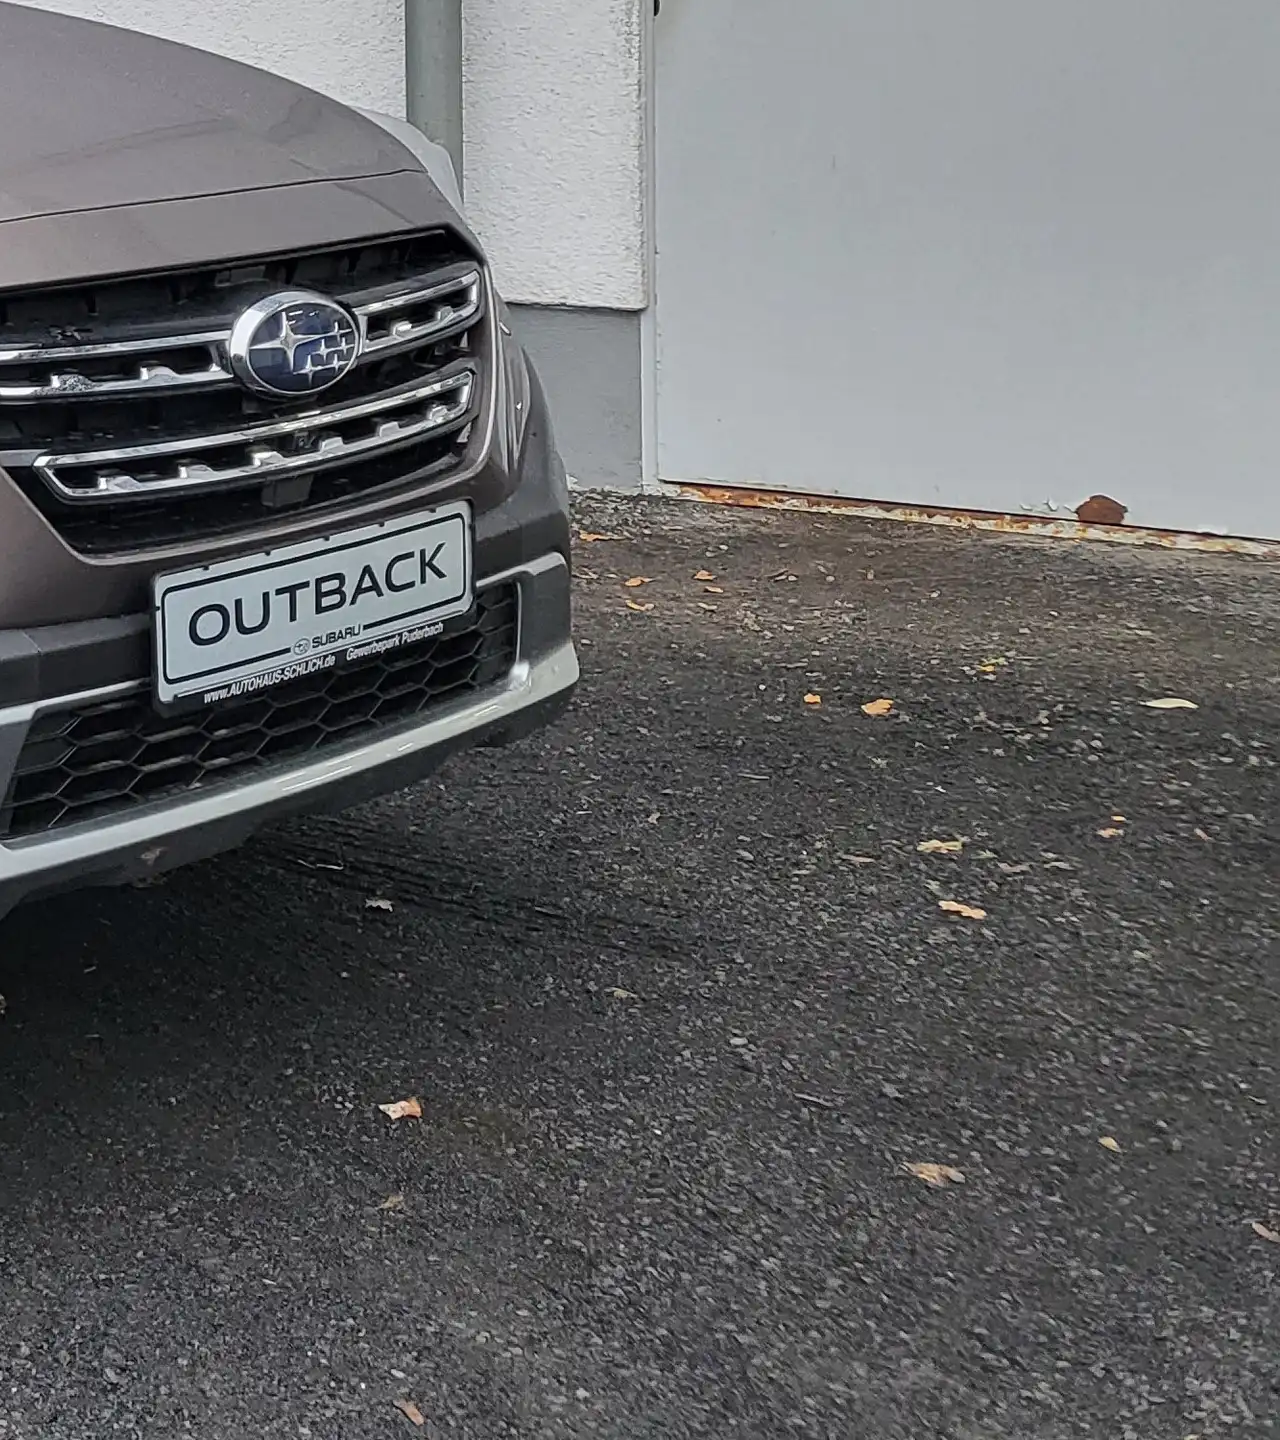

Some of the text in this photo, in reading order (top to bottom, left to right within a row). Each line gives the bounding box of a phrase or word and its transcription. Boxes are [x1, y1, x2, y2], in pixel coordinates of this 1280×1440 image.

[188, 541, 448, 646] OUTBACK
[204, 622, 444, 704] www.AUTOHAUS-SCHLICH.de Gewerbepark Puderbach
[311, 624, 361, 648] SUBARU
